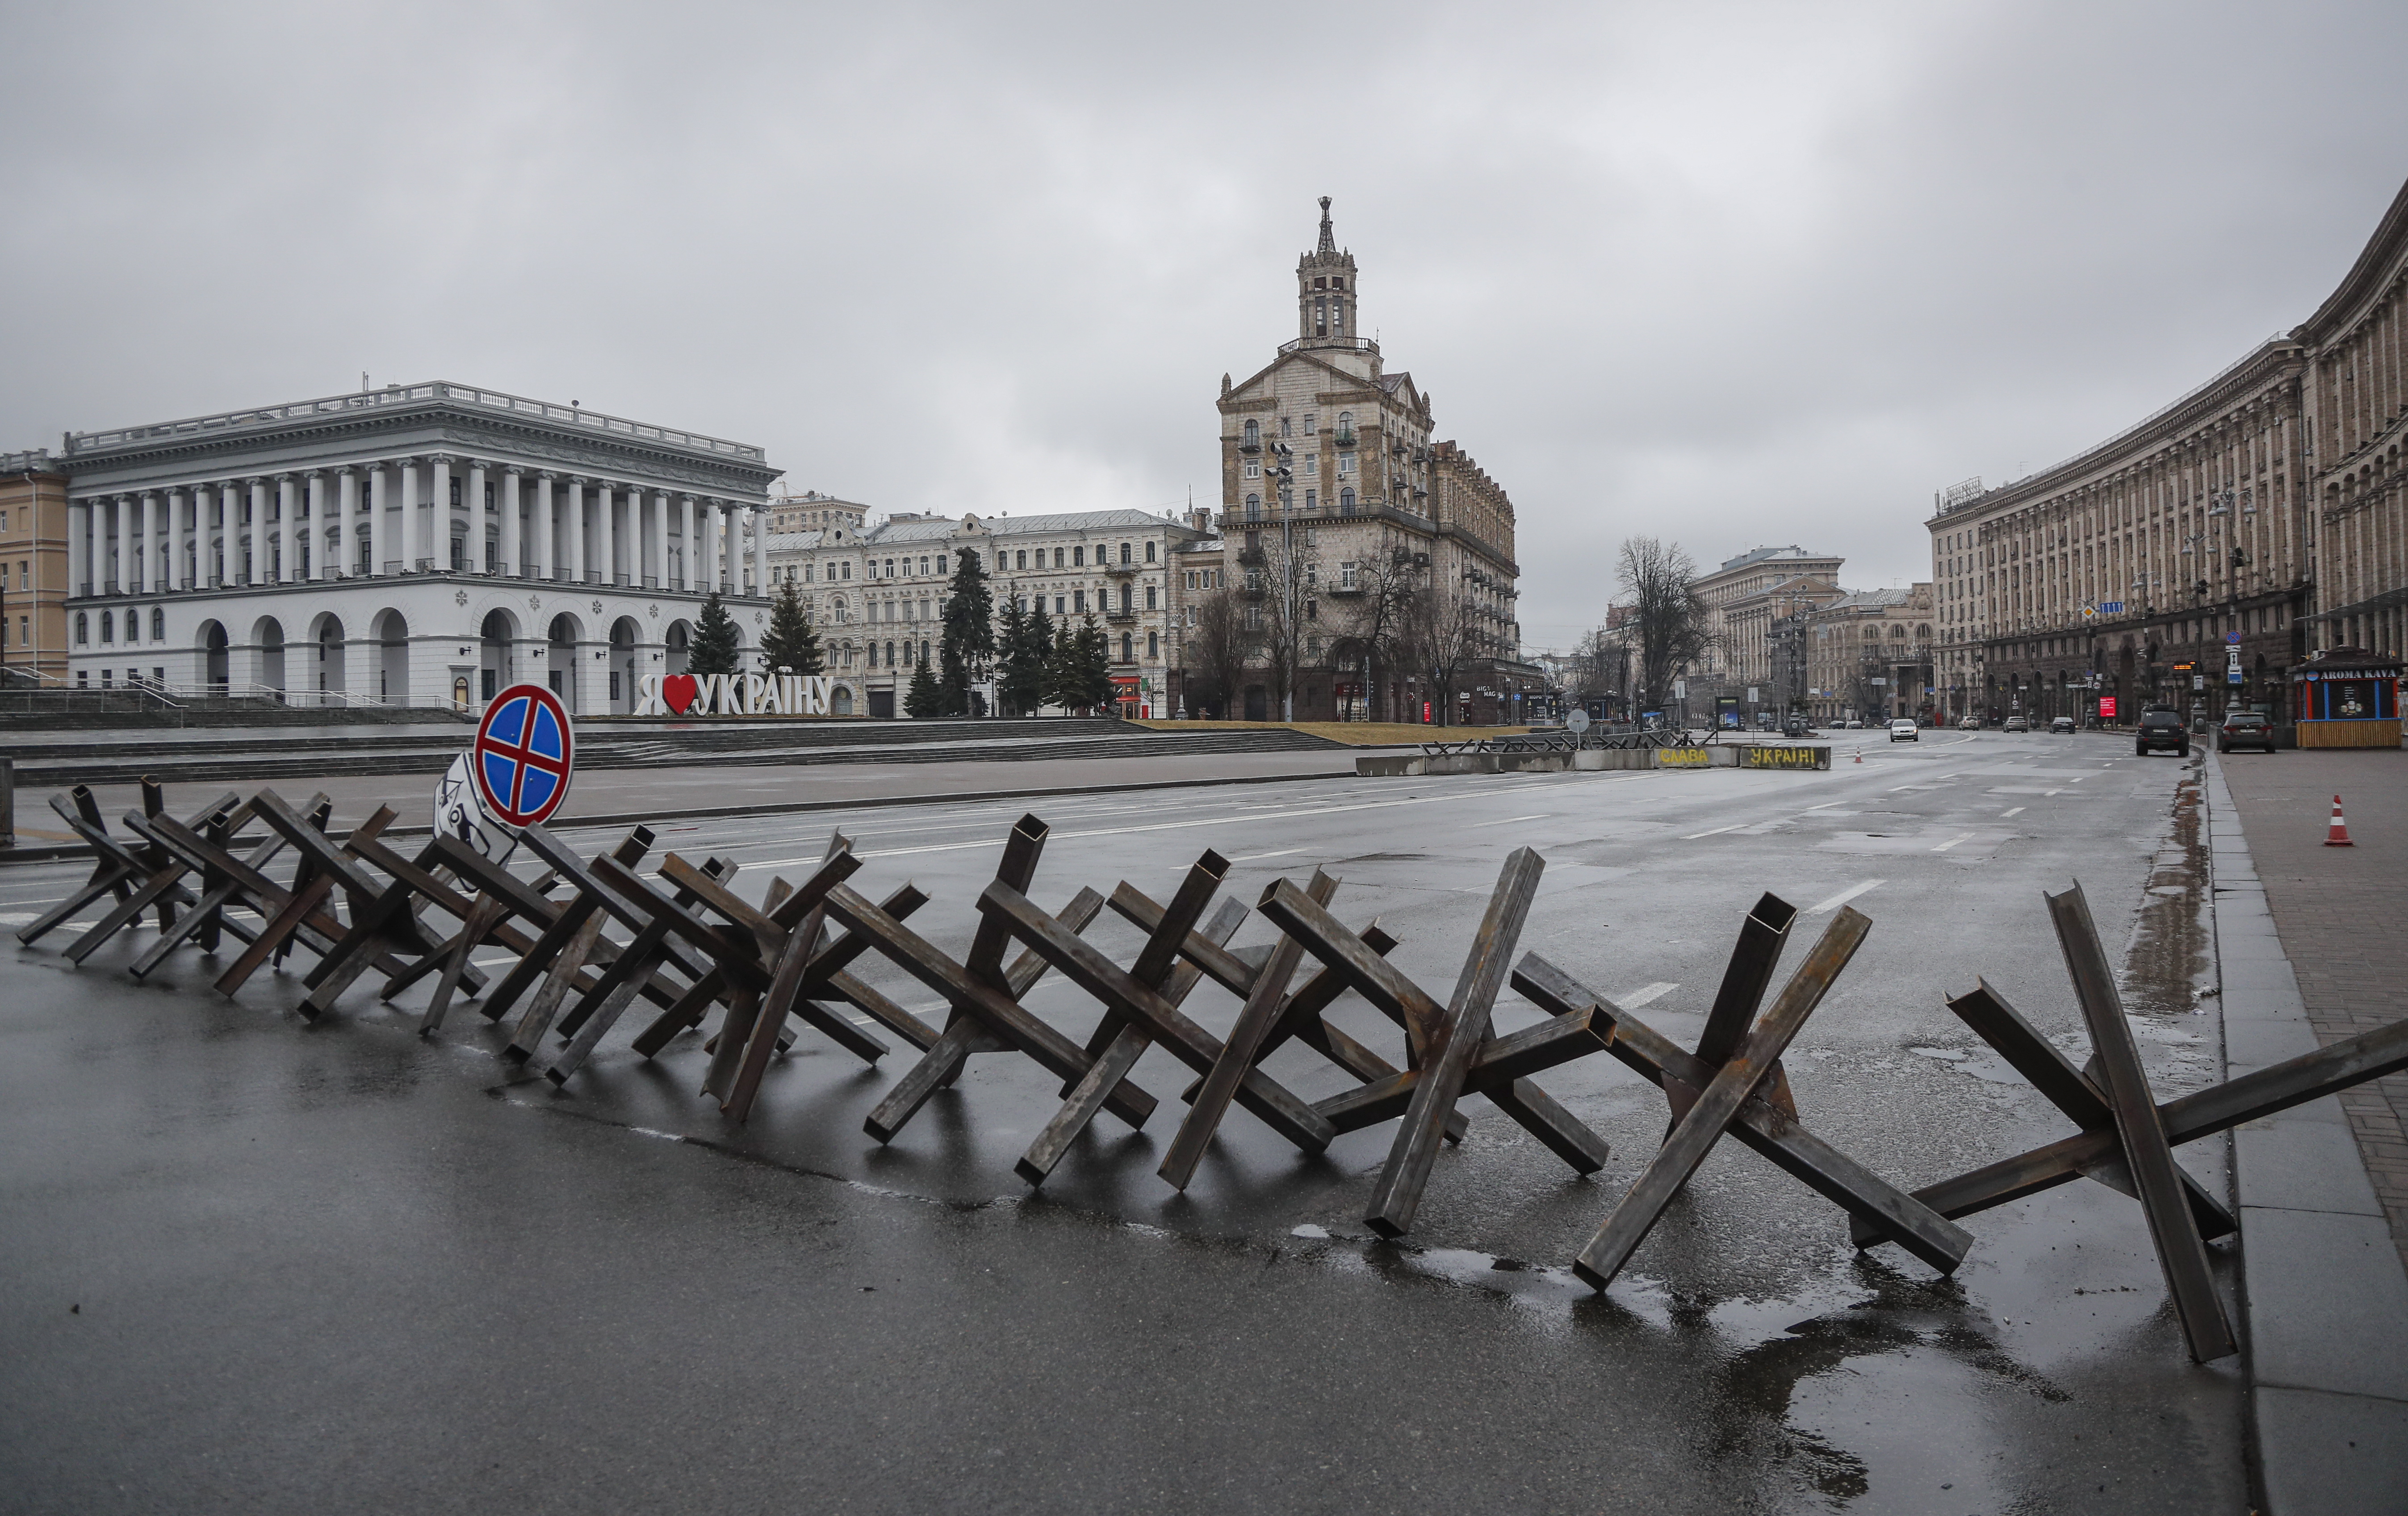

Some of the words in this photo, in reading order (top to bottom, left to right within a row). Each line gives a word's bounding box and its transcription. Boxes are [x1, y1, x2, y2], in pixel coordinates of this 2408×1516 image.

[2321, 671, 2362, 679] AROMA
[2365, 670, 2396, 678] KAVA
[633, 674, 667, 716] Я
[691, 666, 834, 716] УКРАЇНУ
[1660, 749, 1708, 762] СЛАВА
[1750, 747, 1815, 764] УКРАЇНІ
